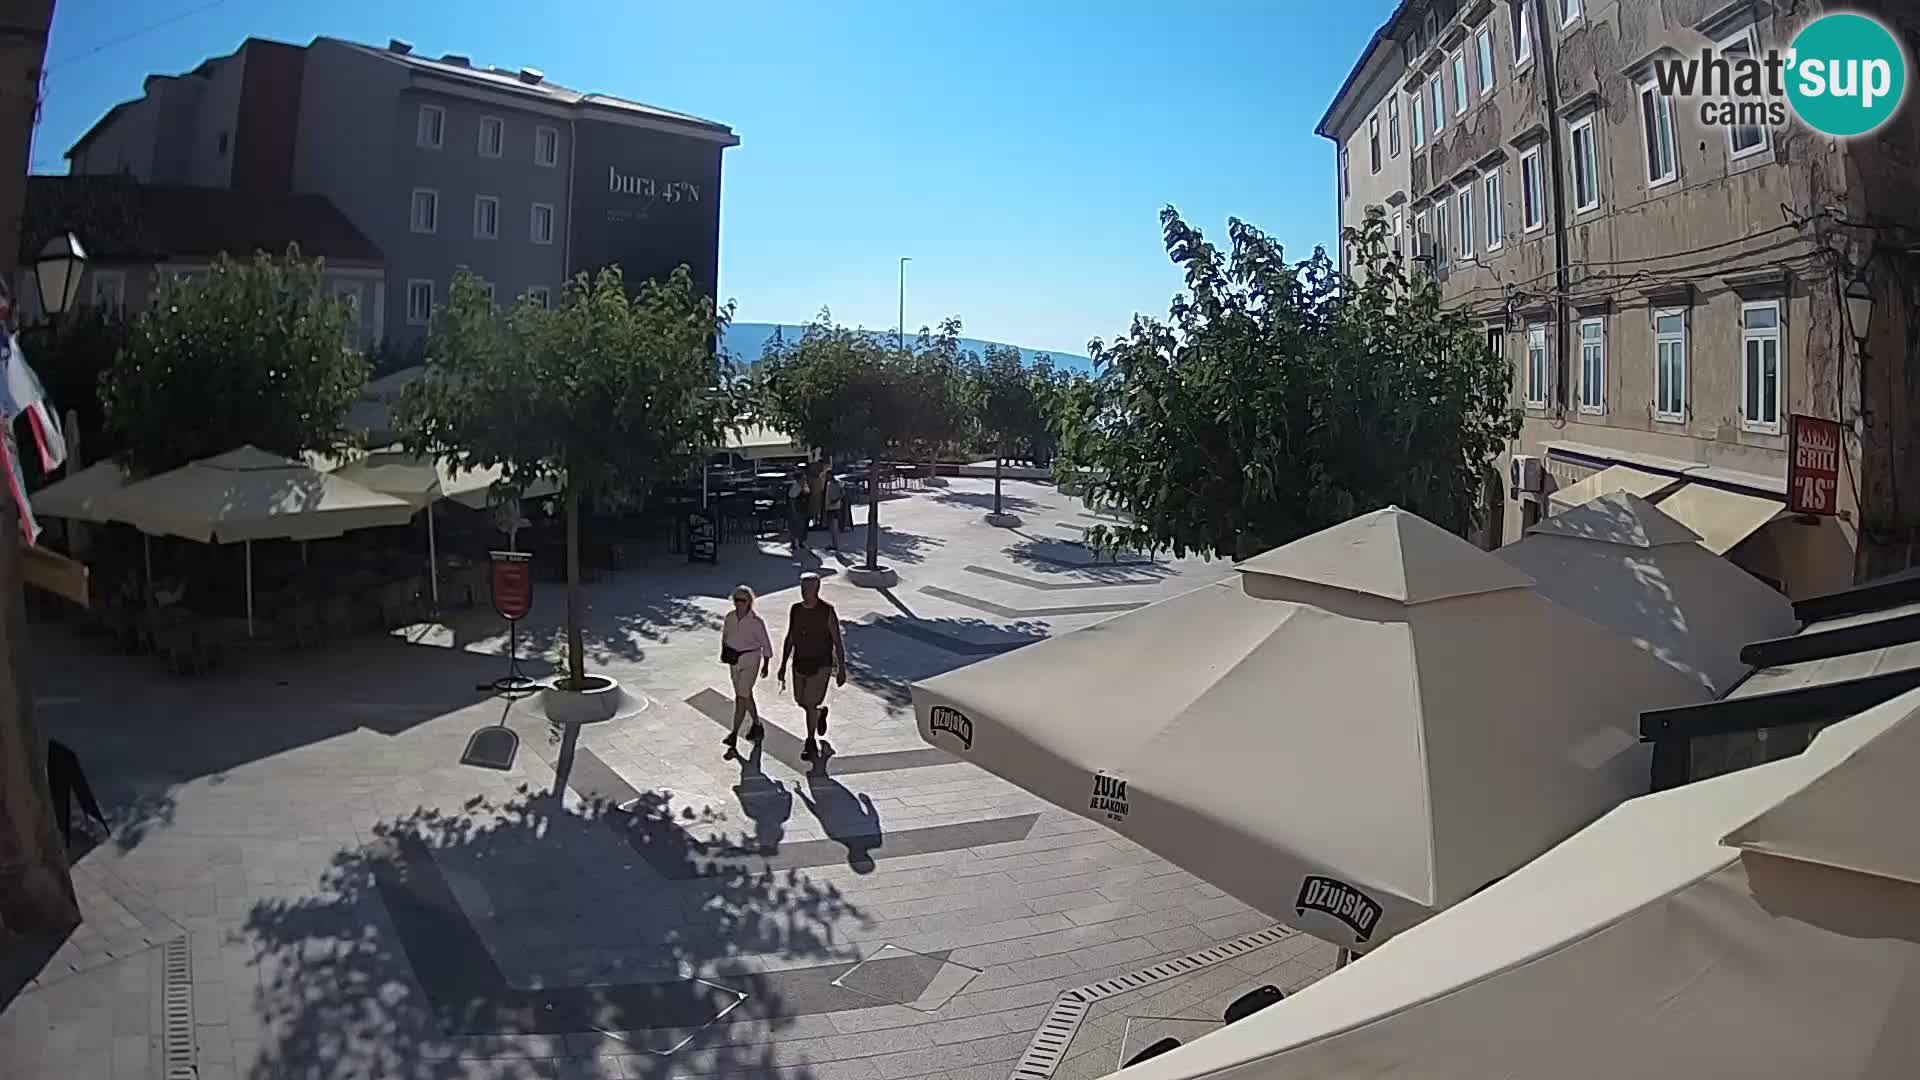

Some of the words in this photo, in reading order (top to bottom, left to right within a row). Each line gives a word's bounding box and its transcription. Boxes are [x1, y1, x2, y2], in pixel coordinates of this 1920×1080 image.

[609, 165, 656, 197] bura
[1796, 448, 1836, 472] GRILL
[1304, 879, 1375, 930] Ožujsko
